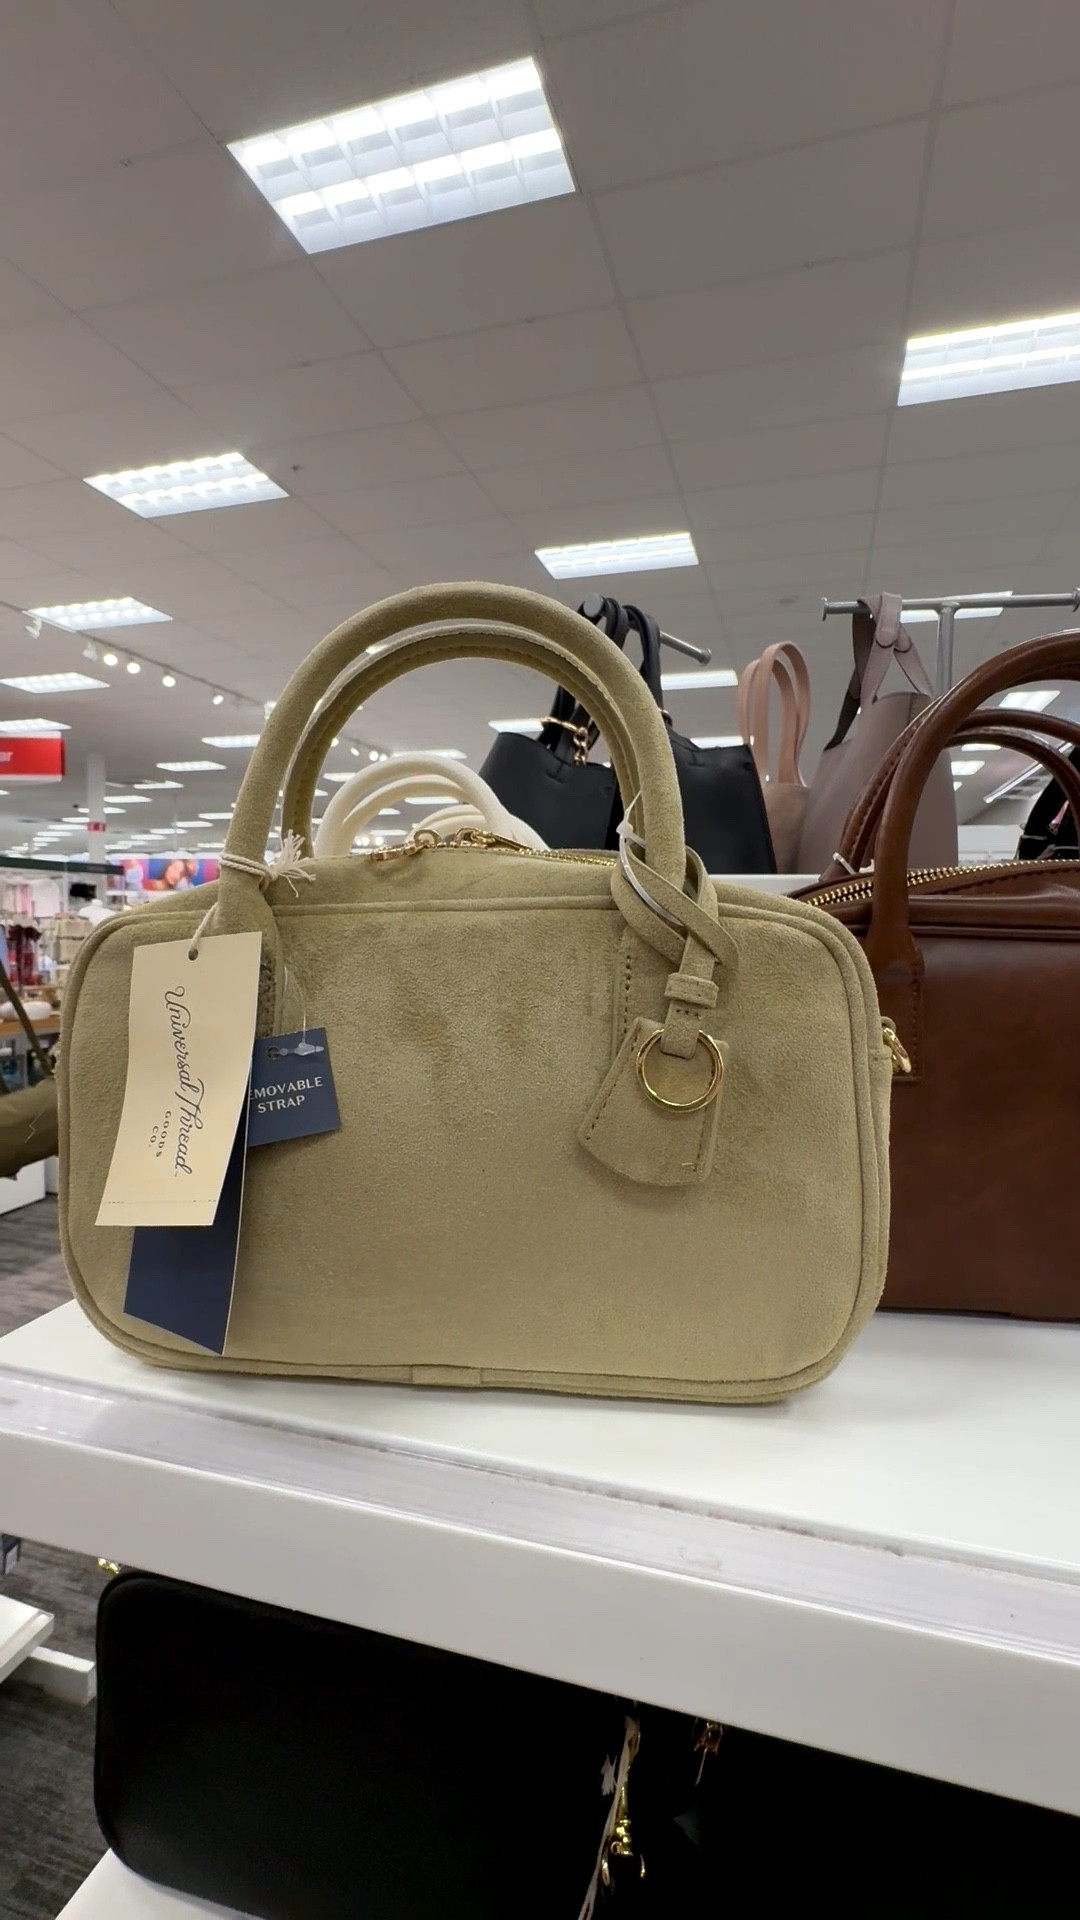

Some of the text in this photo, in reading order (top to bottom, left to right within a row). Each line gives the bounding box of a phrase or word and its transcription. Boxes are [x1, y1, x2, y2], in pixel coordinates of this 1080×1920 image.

[165, 986, 205, 1175] Universal Thread
[257, 1095, 306, 1114] STRAP
[148, 1126, 160, 1147] CO.
[156, 1111, 171, 1158] GOODS
